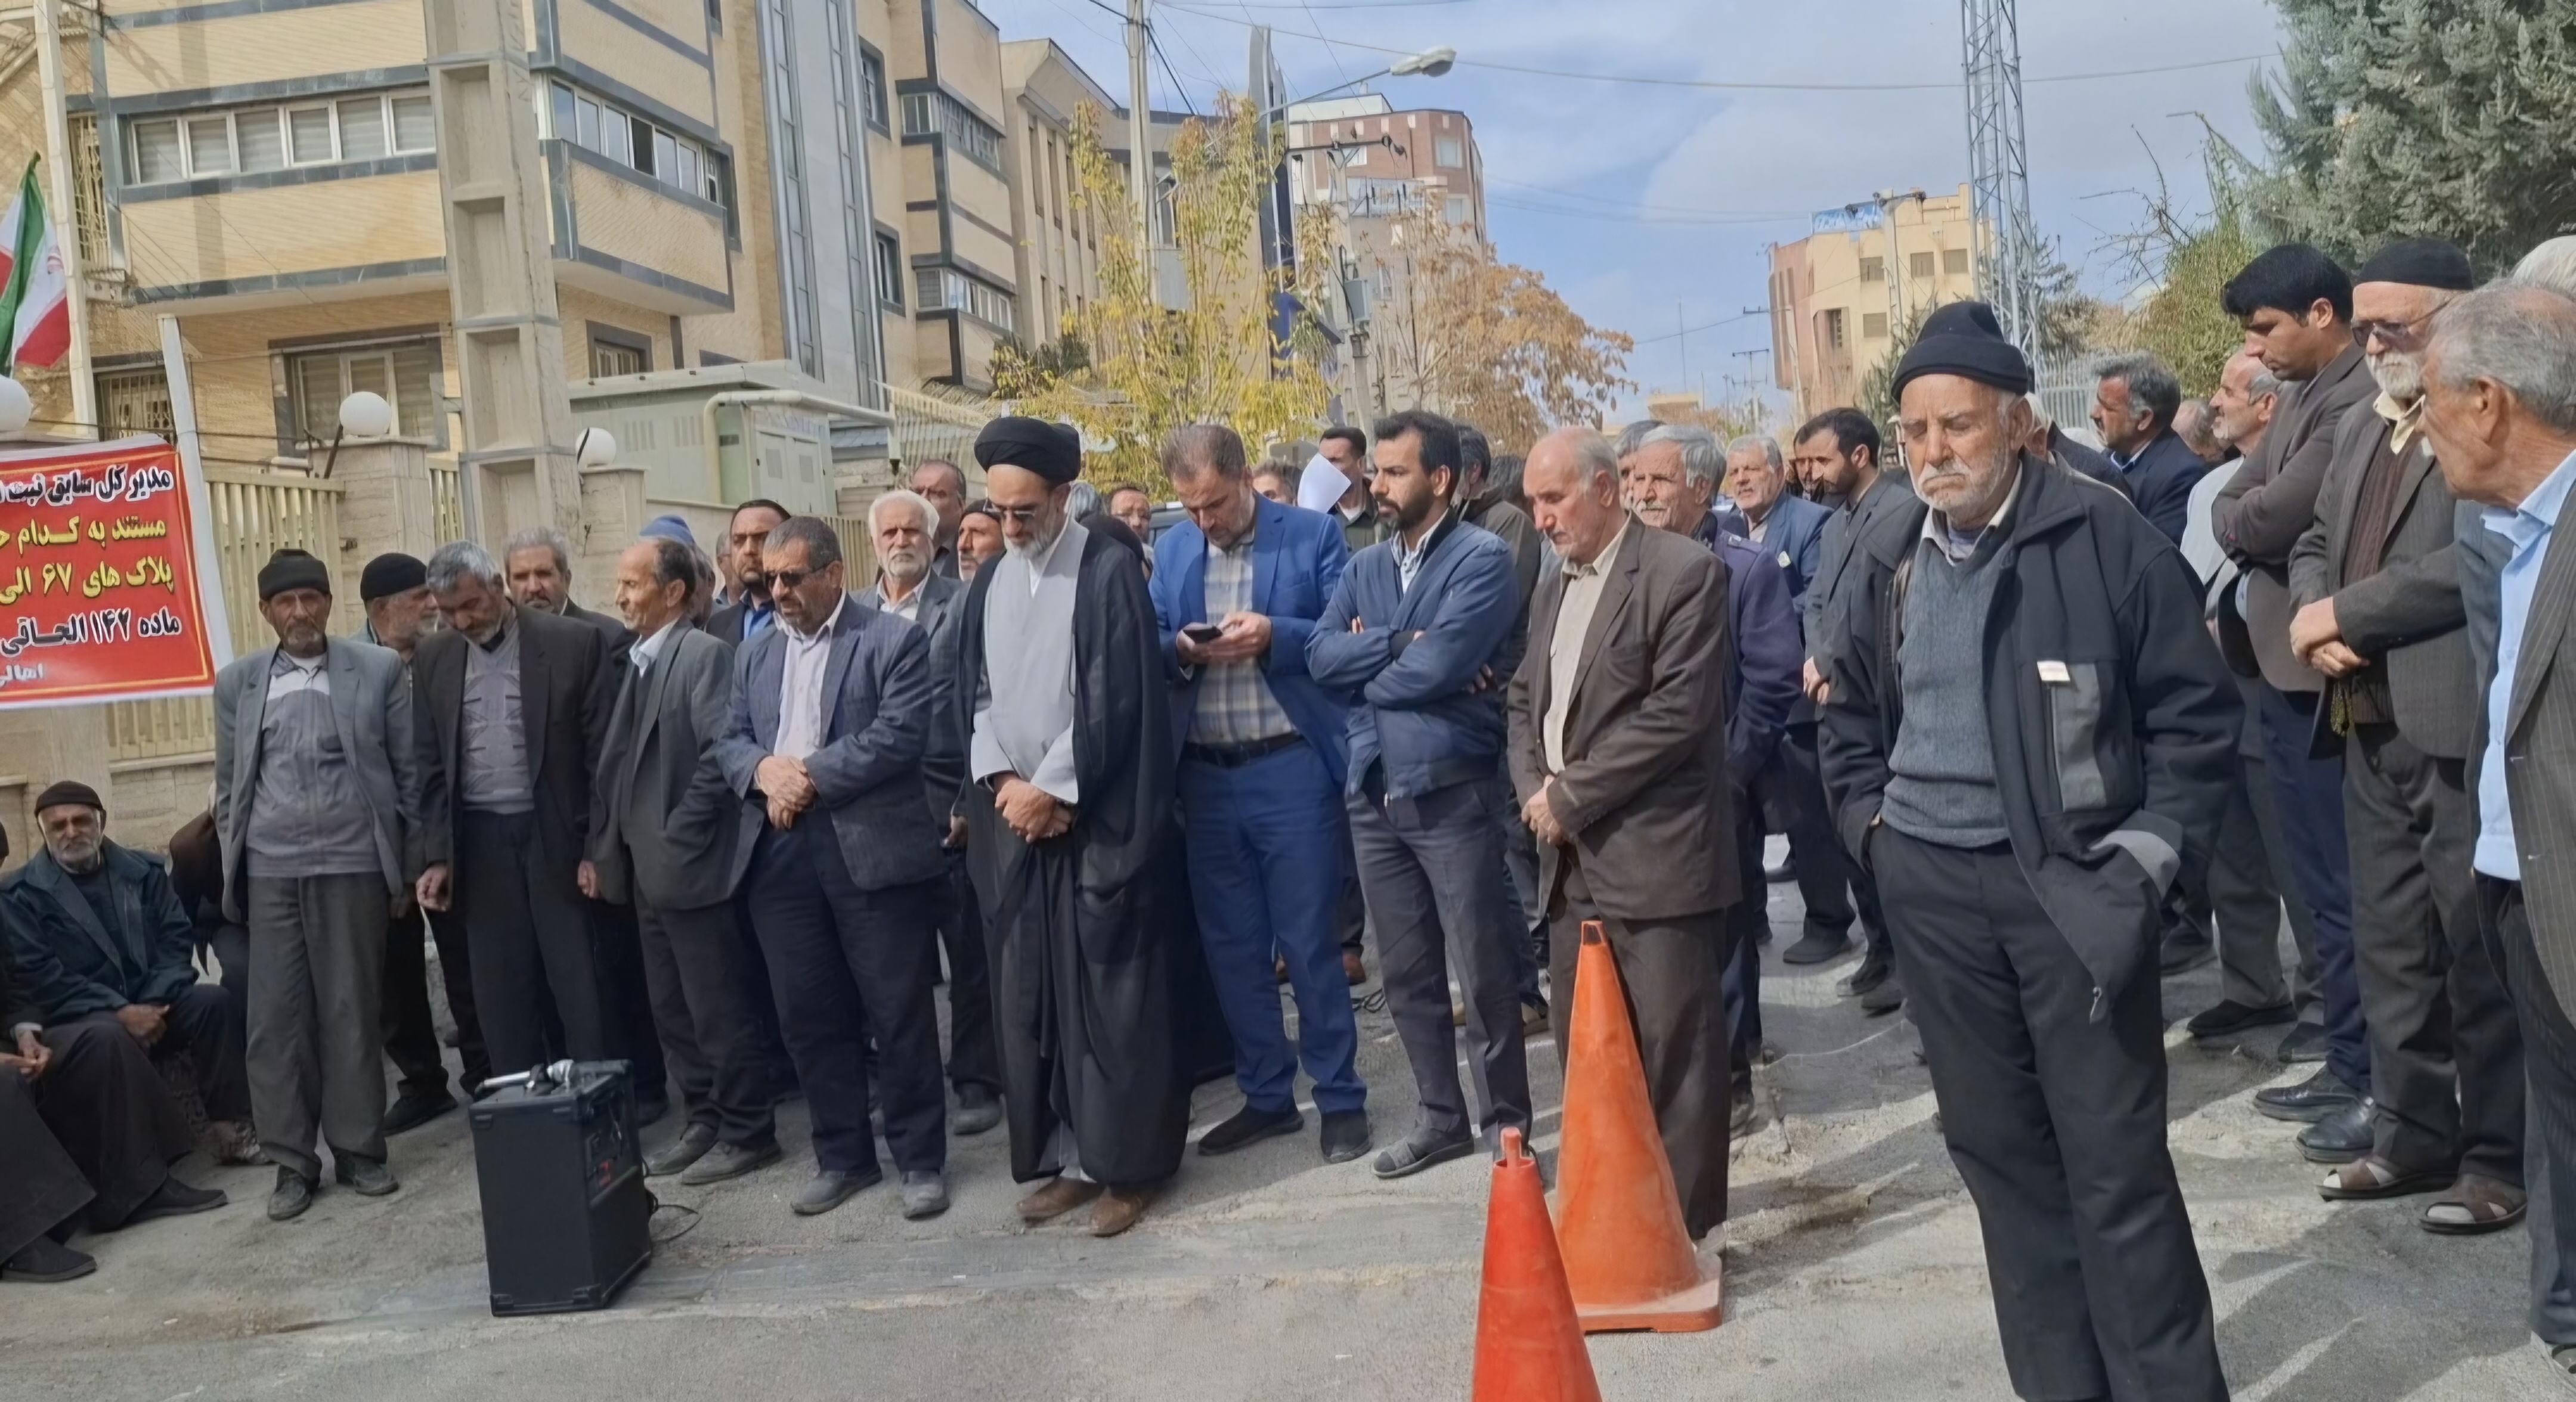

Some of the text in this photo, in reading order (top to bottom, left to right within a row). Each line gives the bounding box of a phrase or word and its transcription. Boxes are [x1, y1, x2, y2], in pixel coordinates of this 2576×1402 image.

[45, 469, 94, 506] سابق
[96, 464, 128, 502] کل
[125, 466, 174, 501] مدیر
[18, 516, 80, 556] کدام
[88, 520, 105, 548] به
[112, 516, 166, 541] مستند
[0, 556, 174, 604] پلاک های ۶۷ الی
[1, 612, 88, 657] الحاقی
[138, 606, 181, 637] ماده
